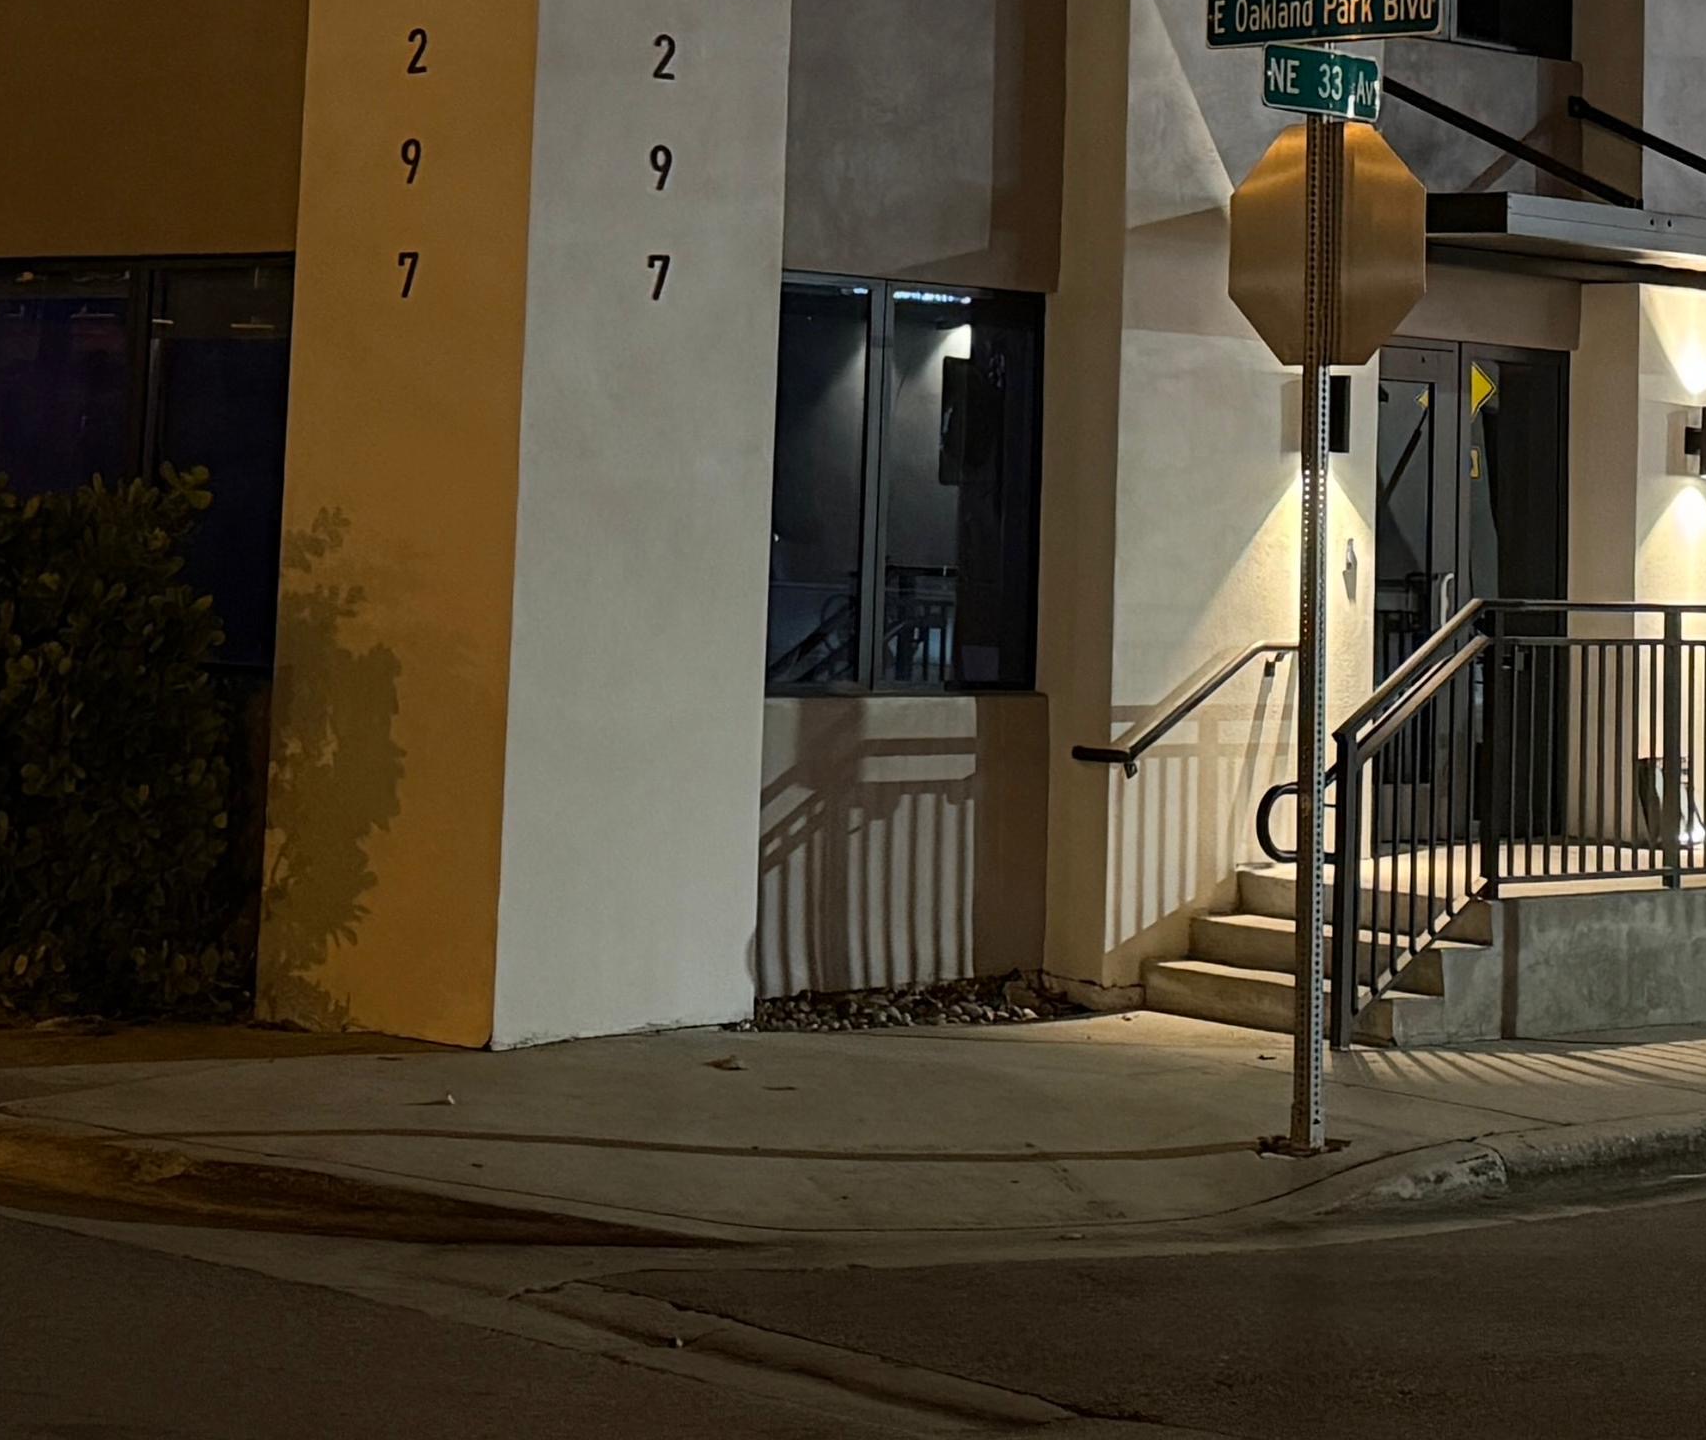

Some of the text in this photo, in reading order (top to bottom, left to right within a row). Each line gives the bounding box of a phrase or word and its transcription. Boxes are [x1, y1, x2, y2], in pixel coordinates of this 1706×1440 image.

[1212, 0, 1227, 35] E
[1269, 56, 1301, 95] NE
[1317, 62, 1344, 101] 33
